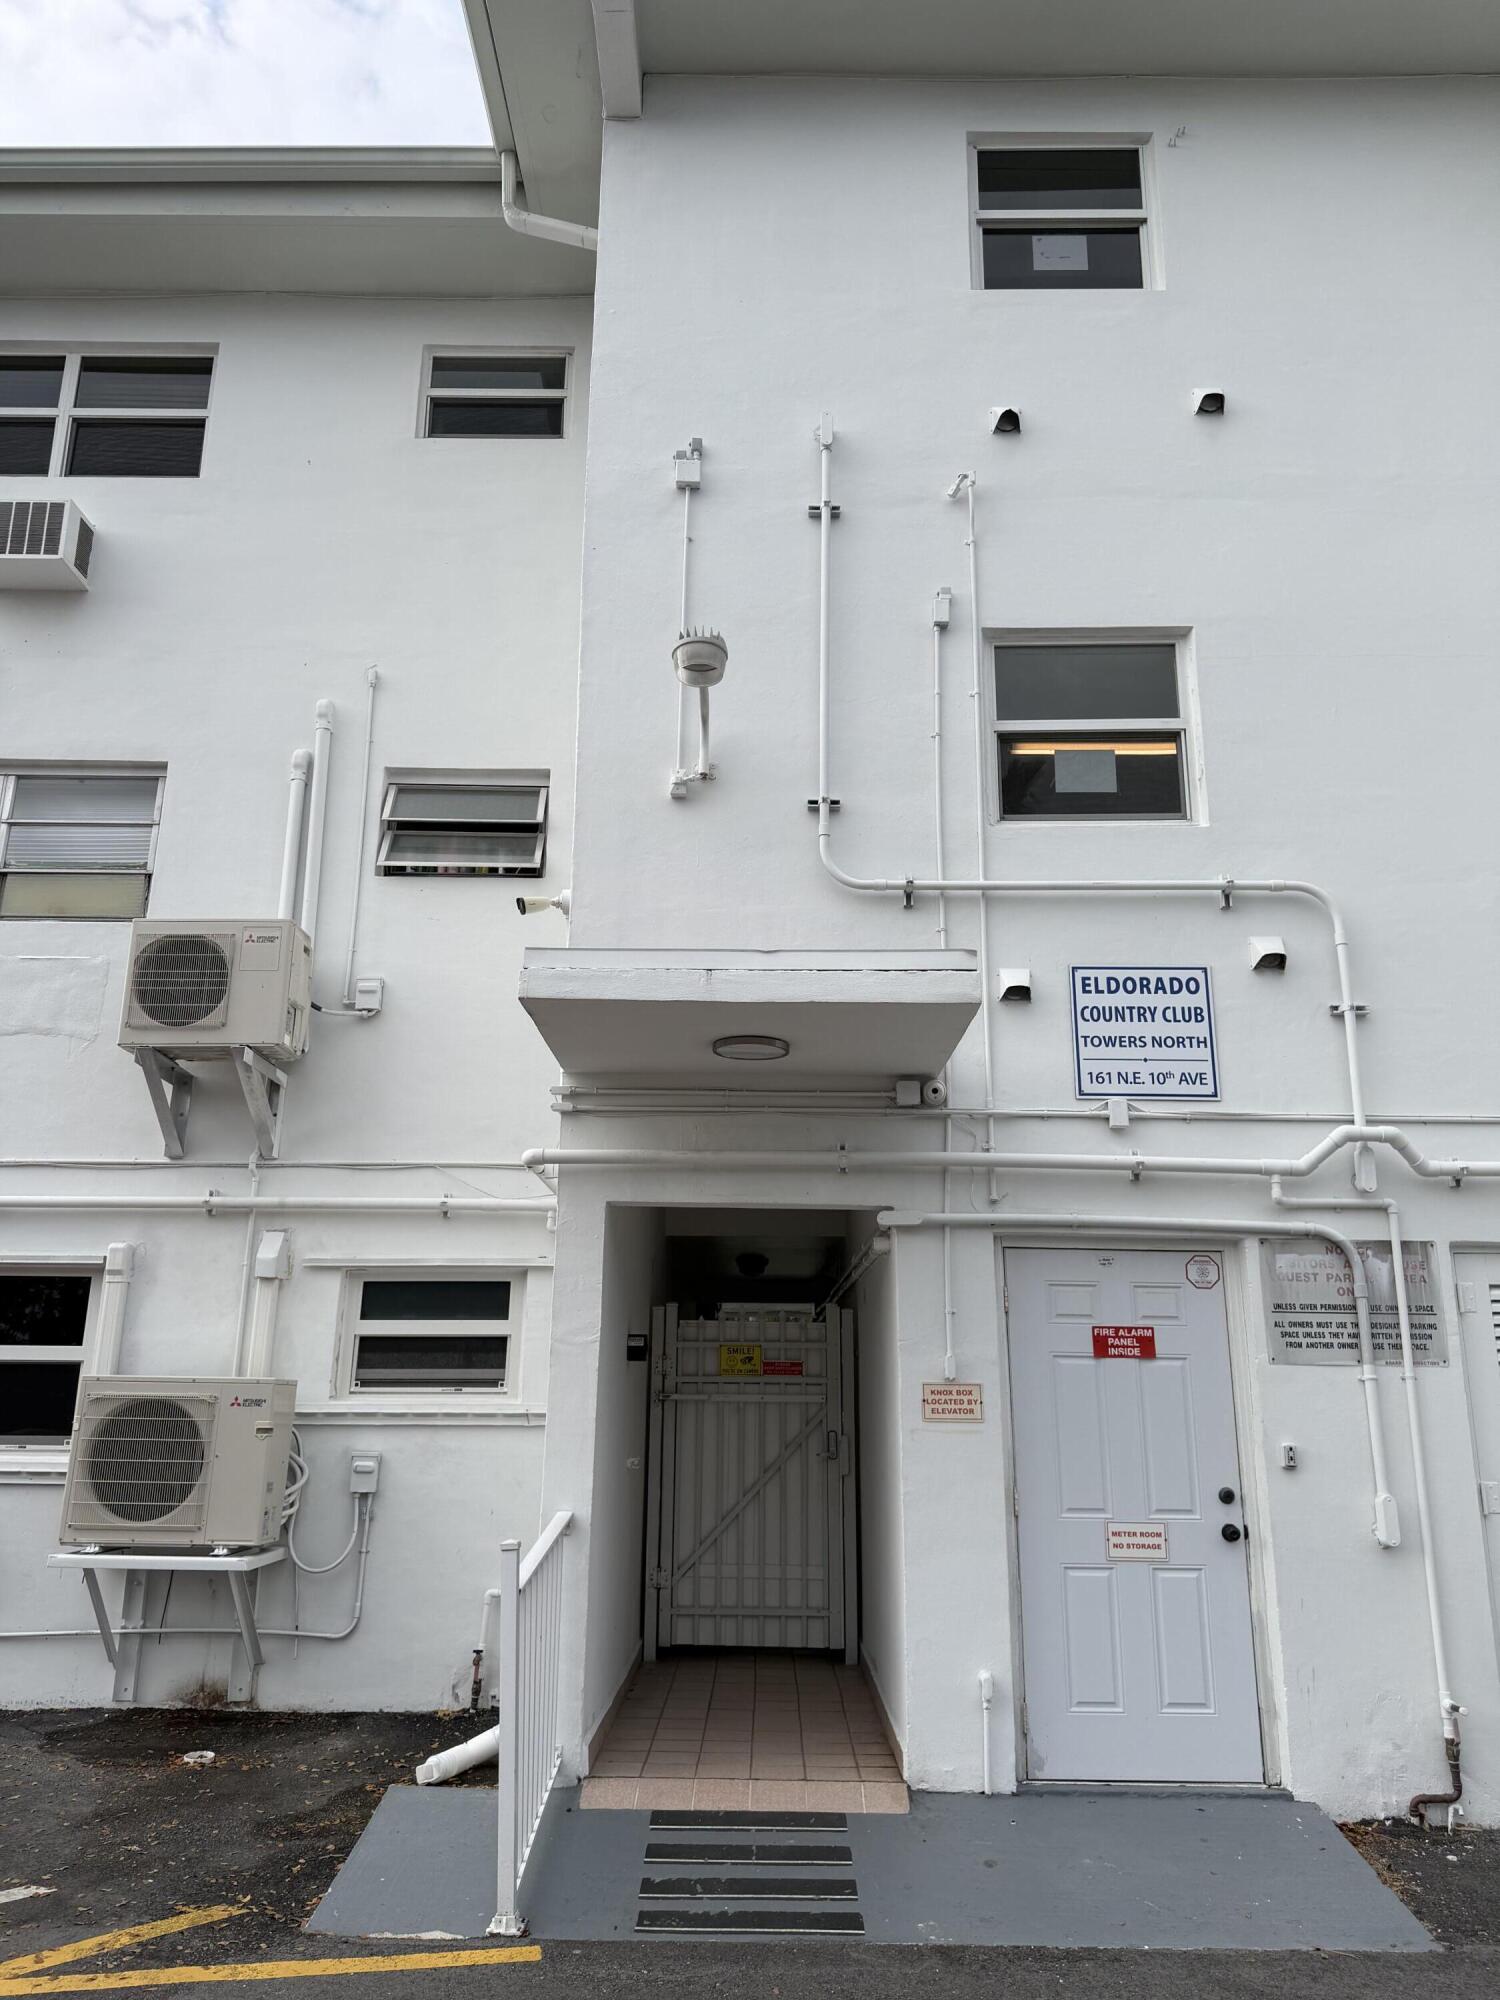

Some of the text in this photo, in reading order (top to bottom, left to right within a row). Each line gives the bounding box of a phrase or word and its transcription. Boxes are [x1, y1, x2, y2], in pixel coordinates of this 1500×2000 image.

[1081, 976, 1200, 995] ELDORADO
[1080, 1005, 1205, 1023] COUNTRY CLUB
[1081, 1035, 1208, 1049] TOWERS NORTH
[1087, 1070, 1208, 1085] 161 N.E. 10th AVE
[1273, 1303, 1296, 1311] UNLESS
[1299, 1303, 1317, 1311] GIVEN
[1320, 1303, 1357, 1311] PERMISSION
[1370, 1304, 1382, 1312] USE
[1274, 1320, 1285, 1328] ALL
[1316, 1321, 1332, 1329] MUST
[1335, 1321, 1347, 1329] USE
[1370, 1322, 1400, 1330] DESIGNAT
[1094, 1328, 1152, 1337] FIRE ALARM
[1280, 1331, 1300, 1339] SPACE
[1302, 1331, 1326, 1339] UNLESS
[1371, 1332, 1393, 1340] RITTEN
[1108, 1338, 1140, 1346] PANEL
[1285, 1341, 1302, 1349] FROM
[1108, 1348, 1141, 1356] INSIDE
[931, 1407, 975, 1415] ELEVATOR
